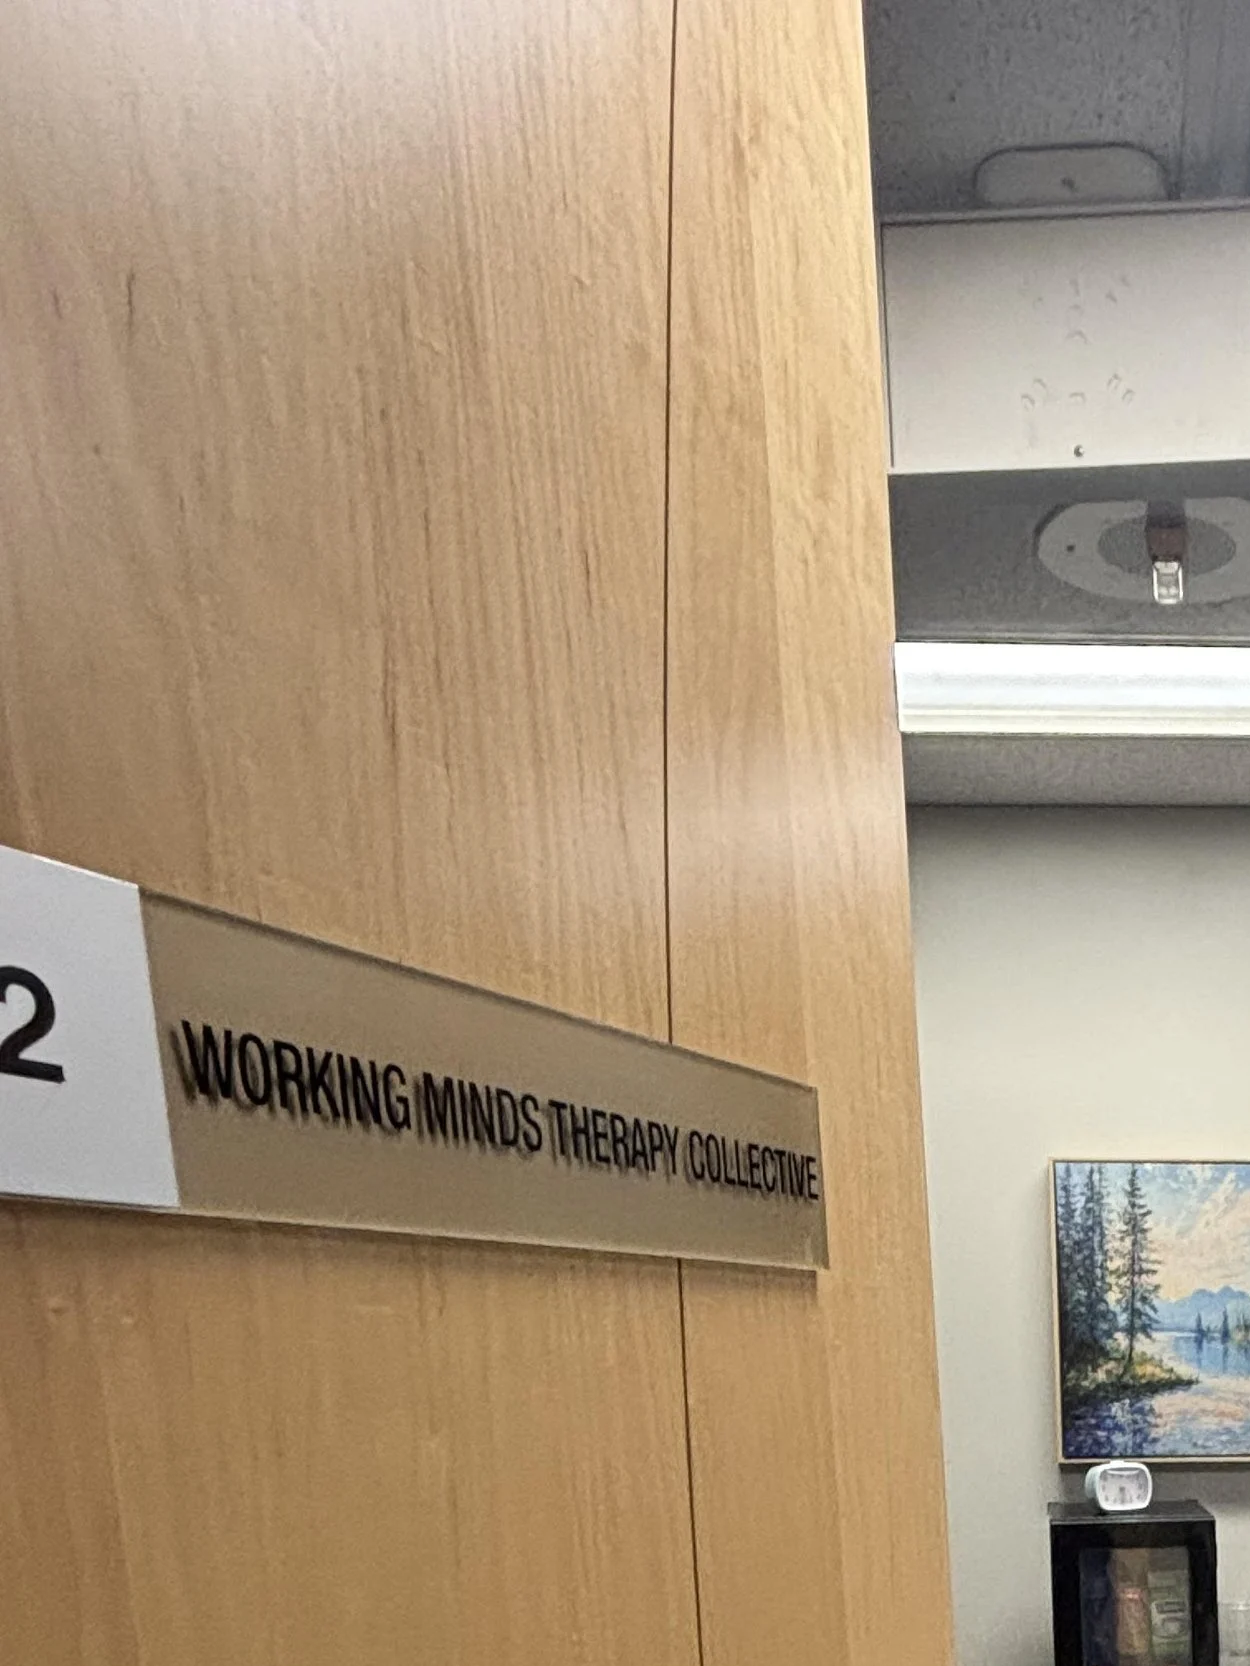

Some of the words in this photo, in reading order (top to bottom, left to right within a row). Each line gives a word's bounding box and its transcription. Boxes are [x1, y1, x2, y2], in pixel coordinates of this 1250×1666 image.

[0, 965, 66, 1085] 2
[180, 1018, 413, 1132] WORKING
[422, 1070, 543, 1153] MINDS
[547, 1098, 680, 1176] THERAPY
[687, 1129, 820, 1201] COLLECTIVE
